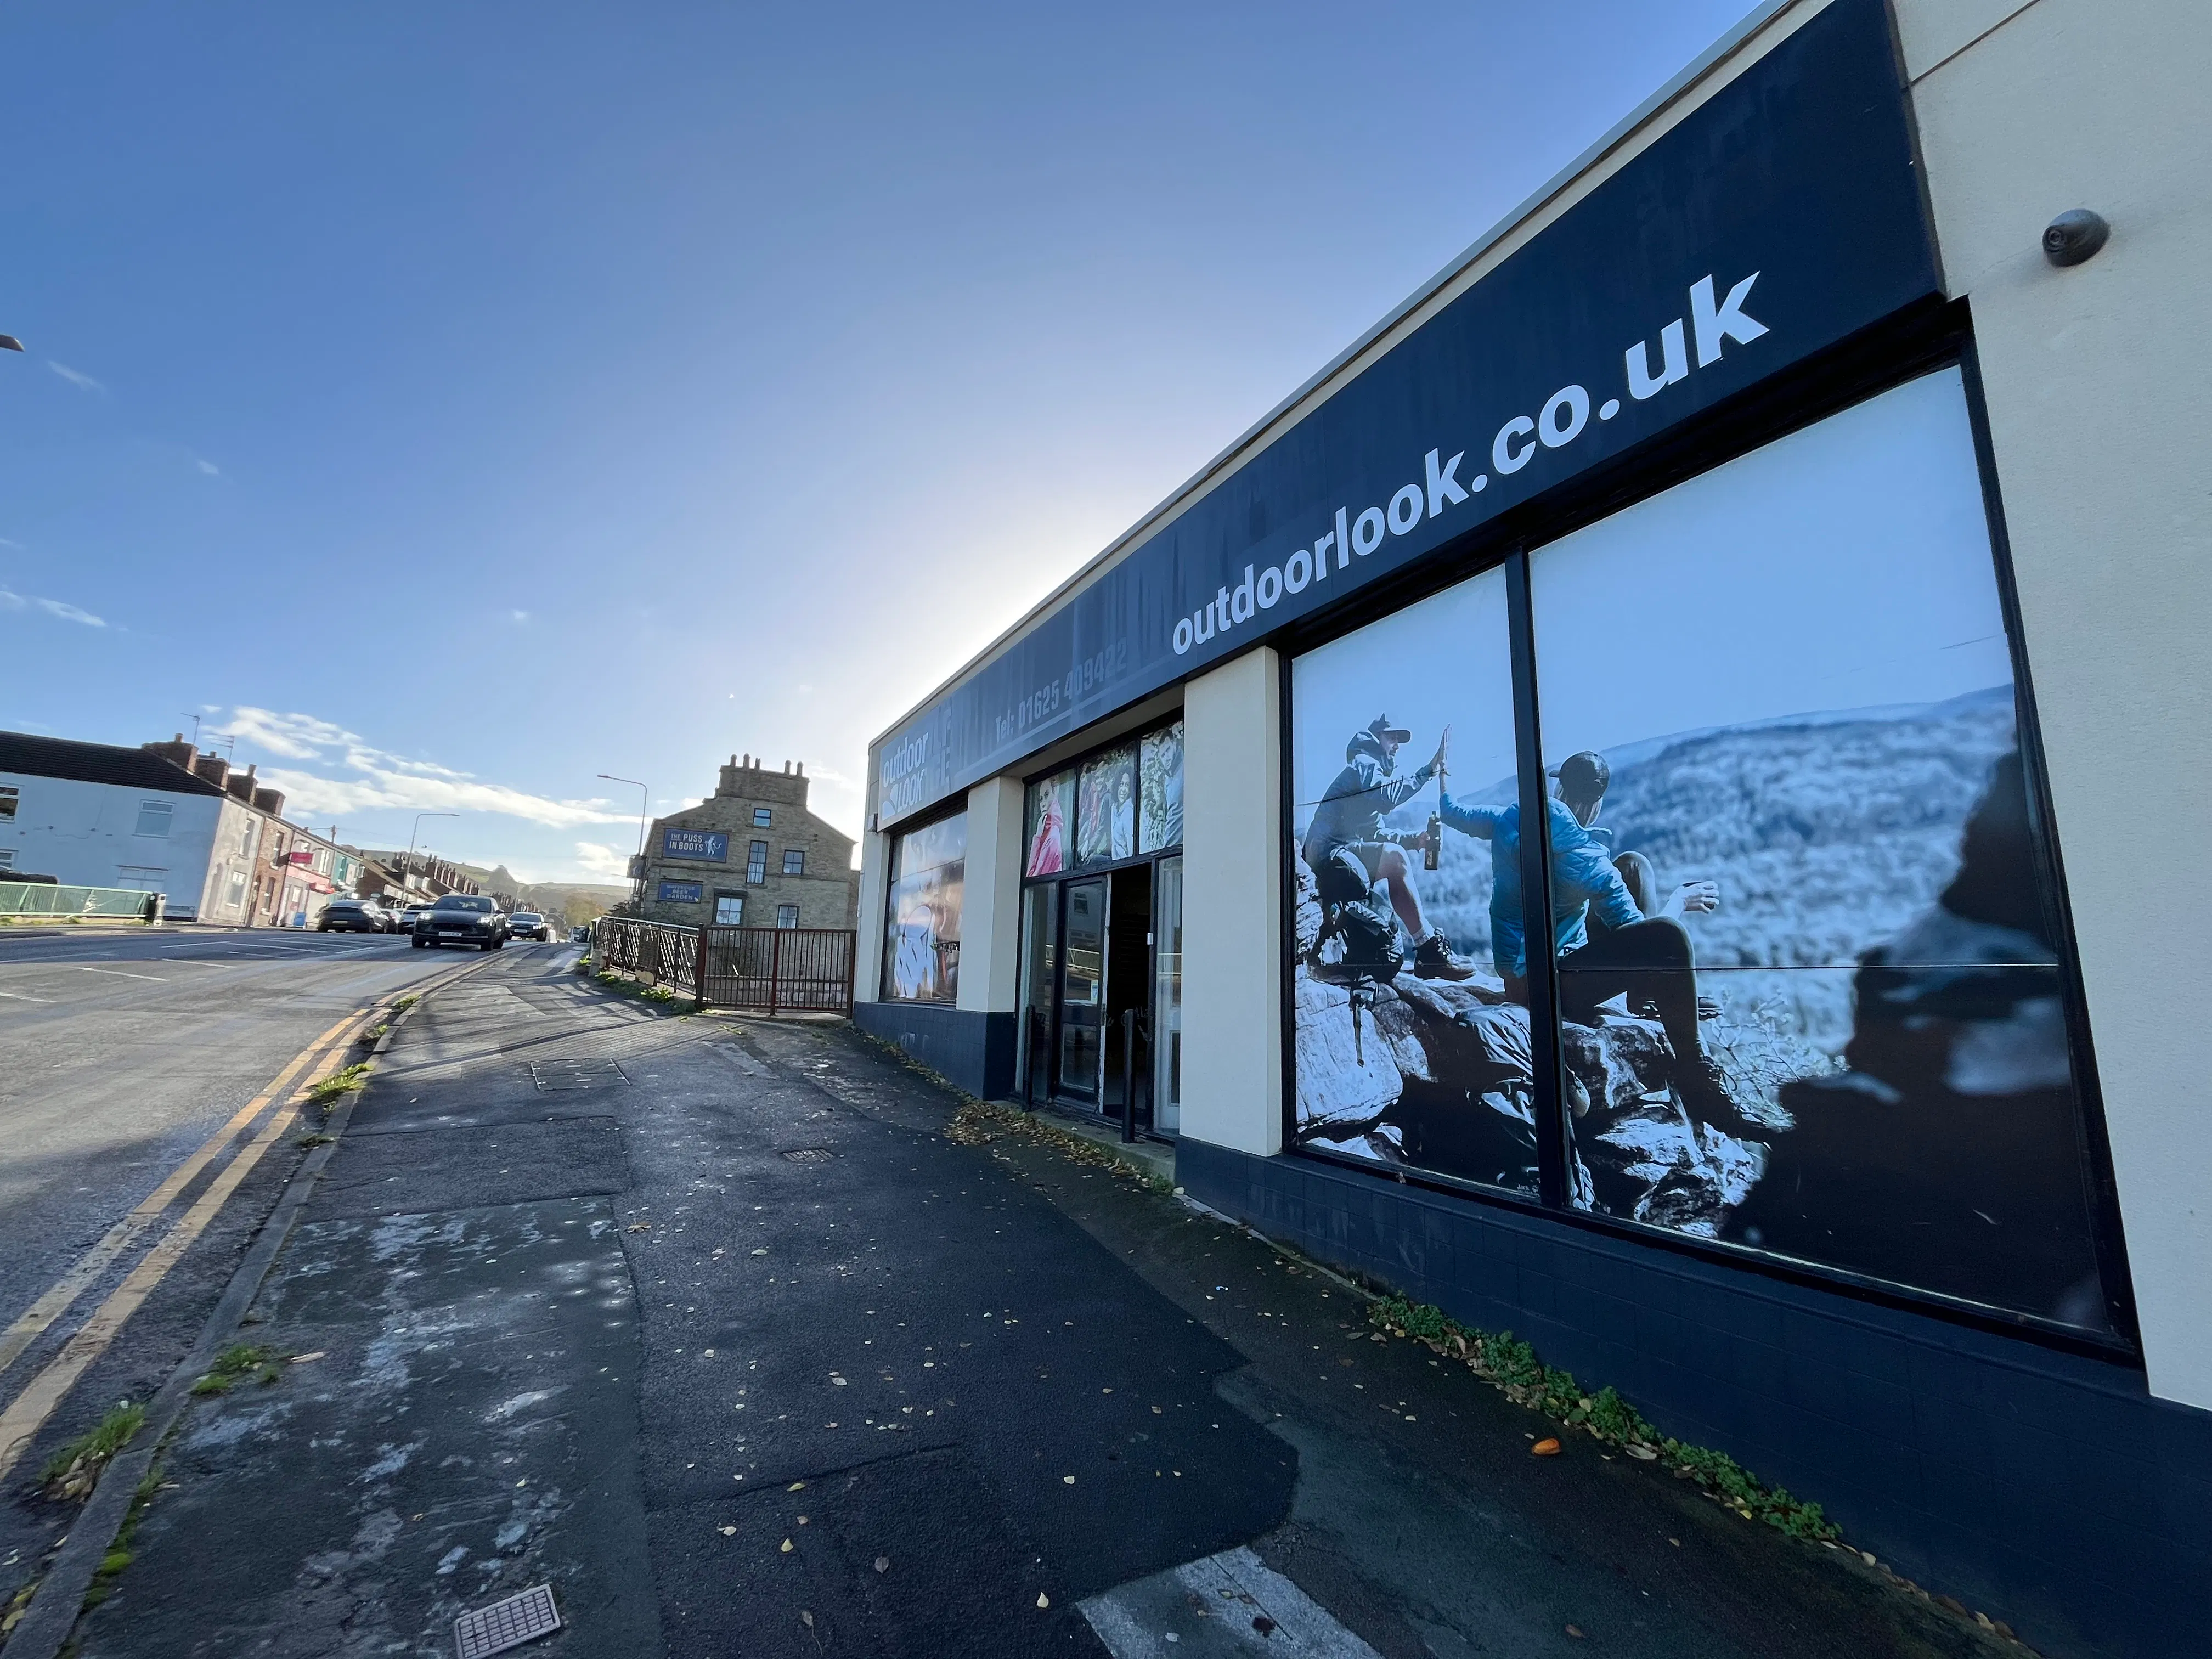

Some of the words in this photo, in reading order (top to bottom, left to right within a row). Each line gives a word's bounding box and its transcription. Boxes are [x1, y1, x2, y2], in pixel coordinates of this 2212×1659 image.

[1172, 270, 1769, 656] outdoorlook.co.uk
[995, 708, 1014, 742] Tel:
[1018, 679, 1059, 729] 01625
[1064, 637, 1127, 700] 409422
[883, 732, 929, 788] outdoor
[897, 769, 926, 813] LOOK
[669, 841, 677, 849] IN
[678, 842, 703, 851] BOOTS
[682, 833, 703, 843] PUSS
